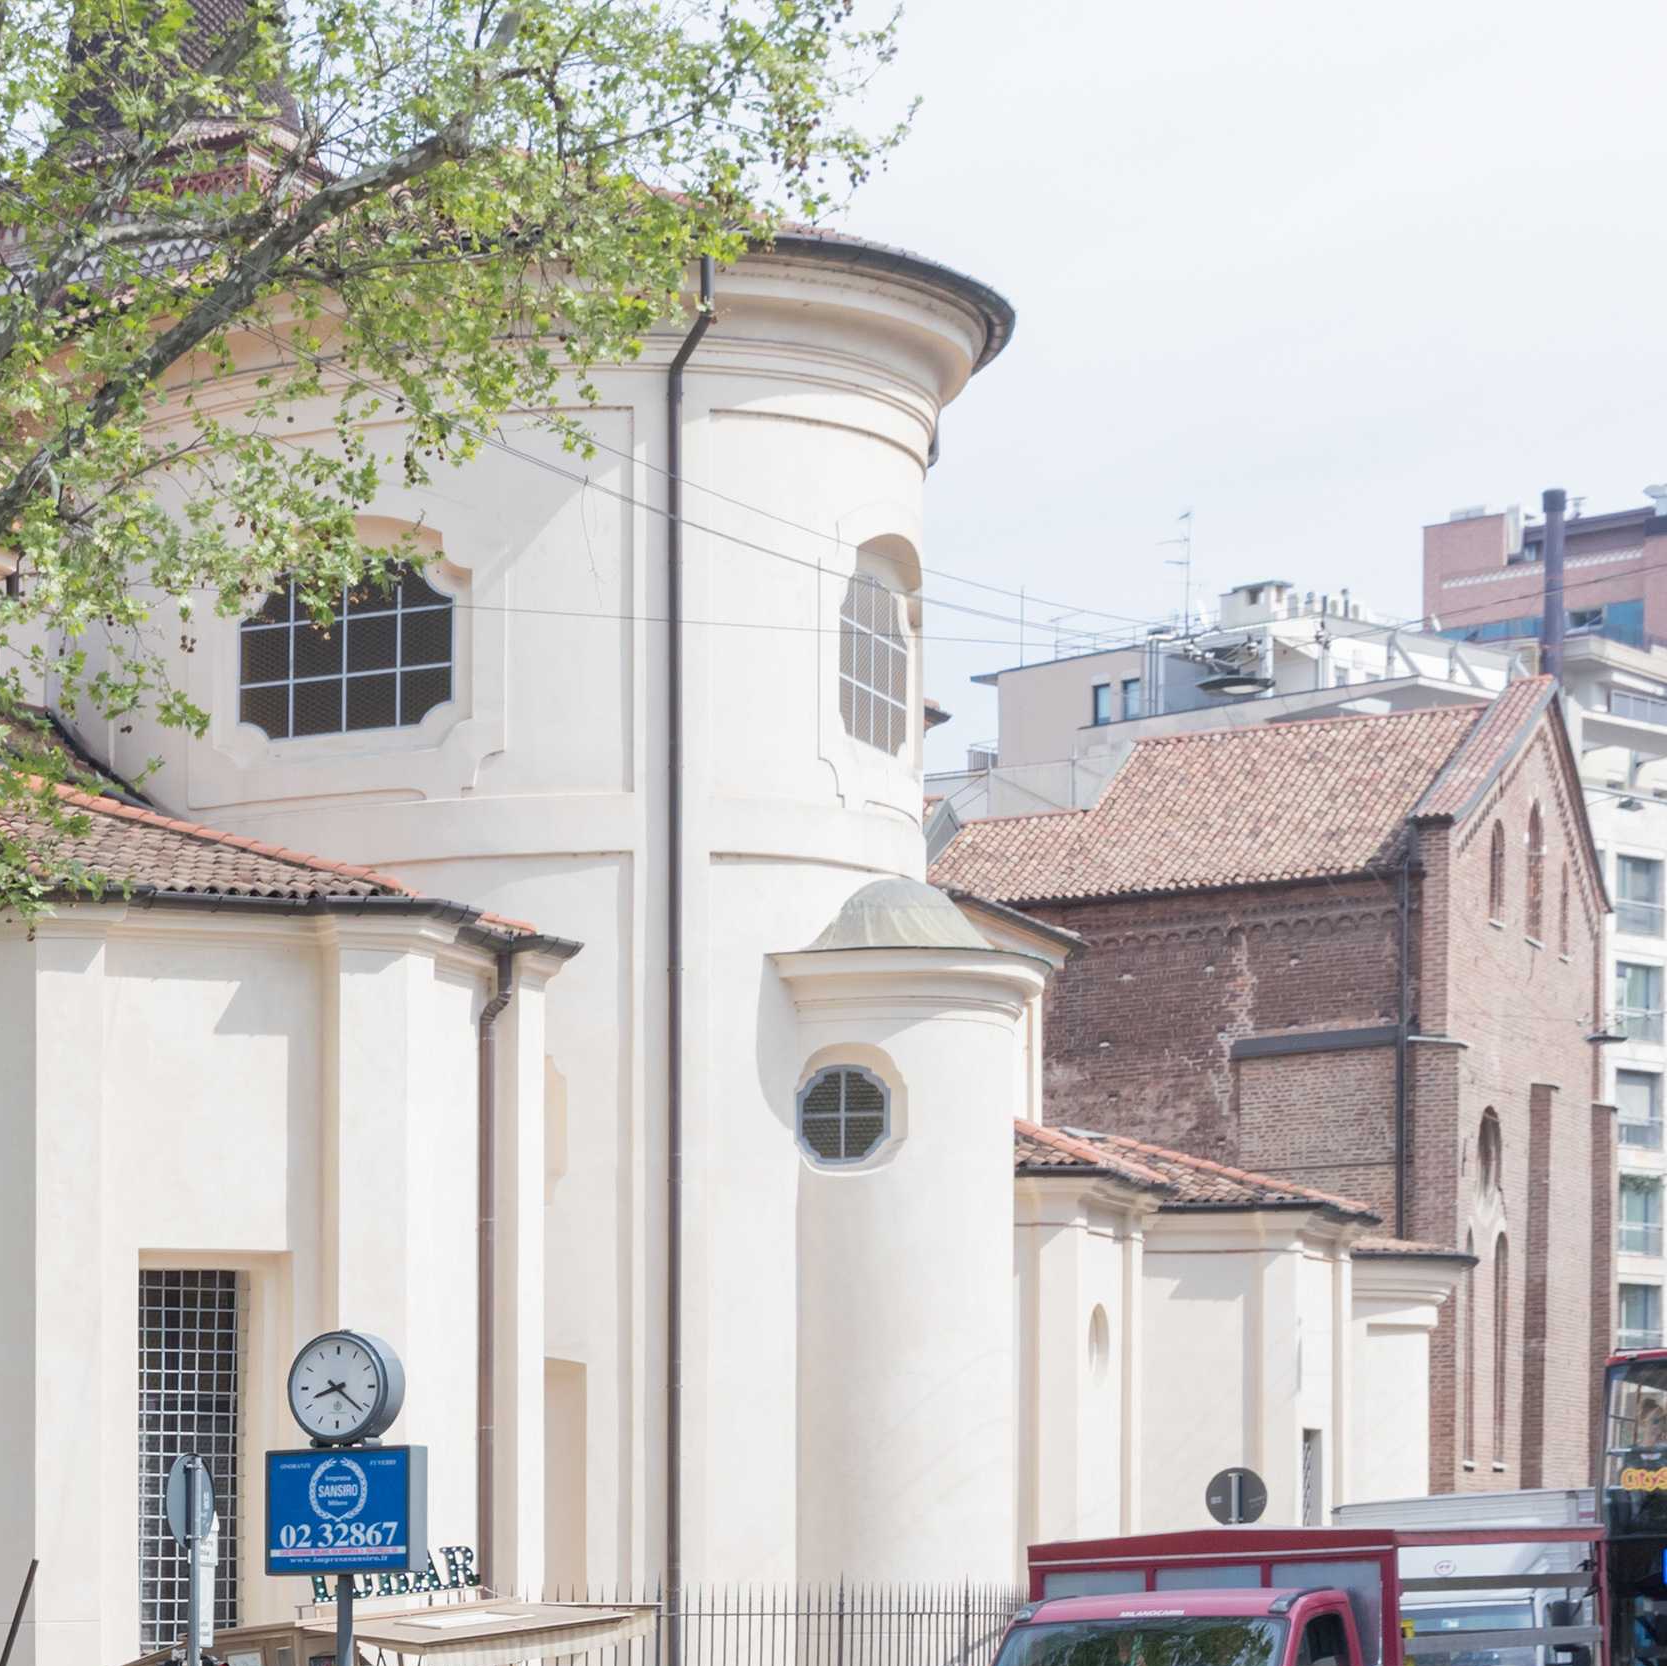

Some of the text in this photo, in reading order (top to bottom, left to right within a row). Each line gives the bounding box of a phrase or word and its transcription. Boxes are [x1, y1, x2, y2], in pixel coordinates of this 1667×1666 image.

[318, 1483, 359, 1498] SANSIRO
[279, 1521, 399, 1549] 02 32867
